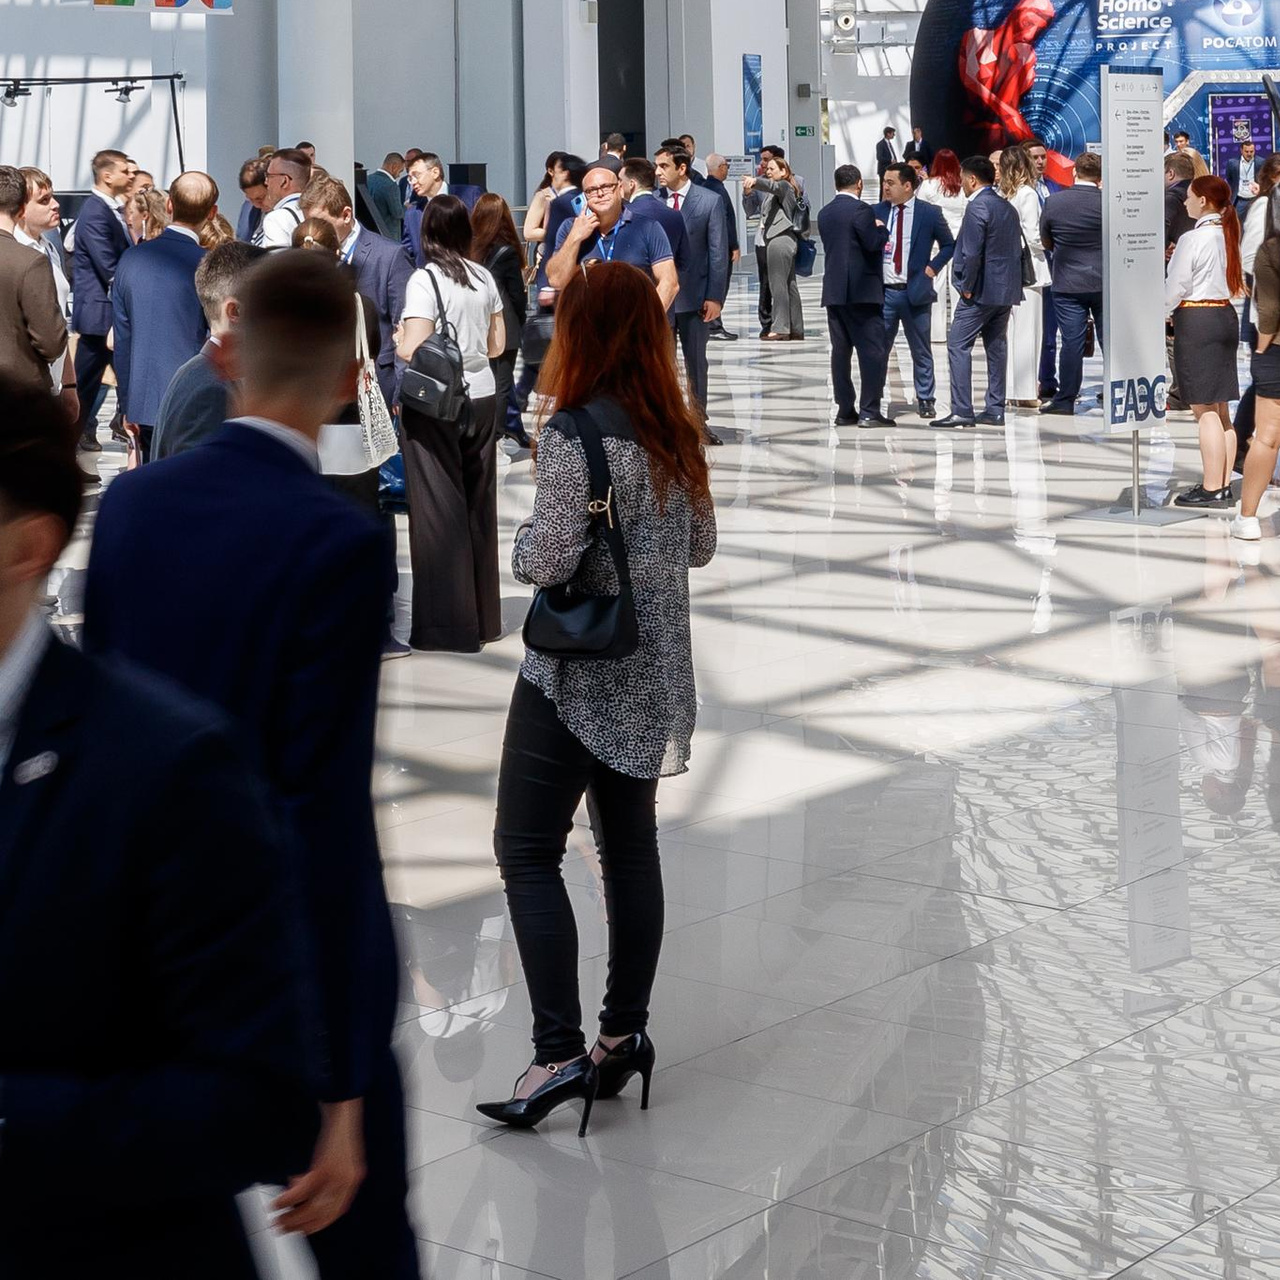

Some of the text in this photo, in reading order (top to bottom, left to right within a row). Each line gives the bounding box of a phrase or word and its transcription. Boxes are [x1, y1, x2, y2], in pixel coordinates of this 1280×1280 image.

[1096, 14, 1172, 31] Science
[1095, 41, 1171, 52] PROJECT
[1202, 36, 1278, 49] РОСАТОМ
[1110, 374, 1166, 425] ЕАЭС
